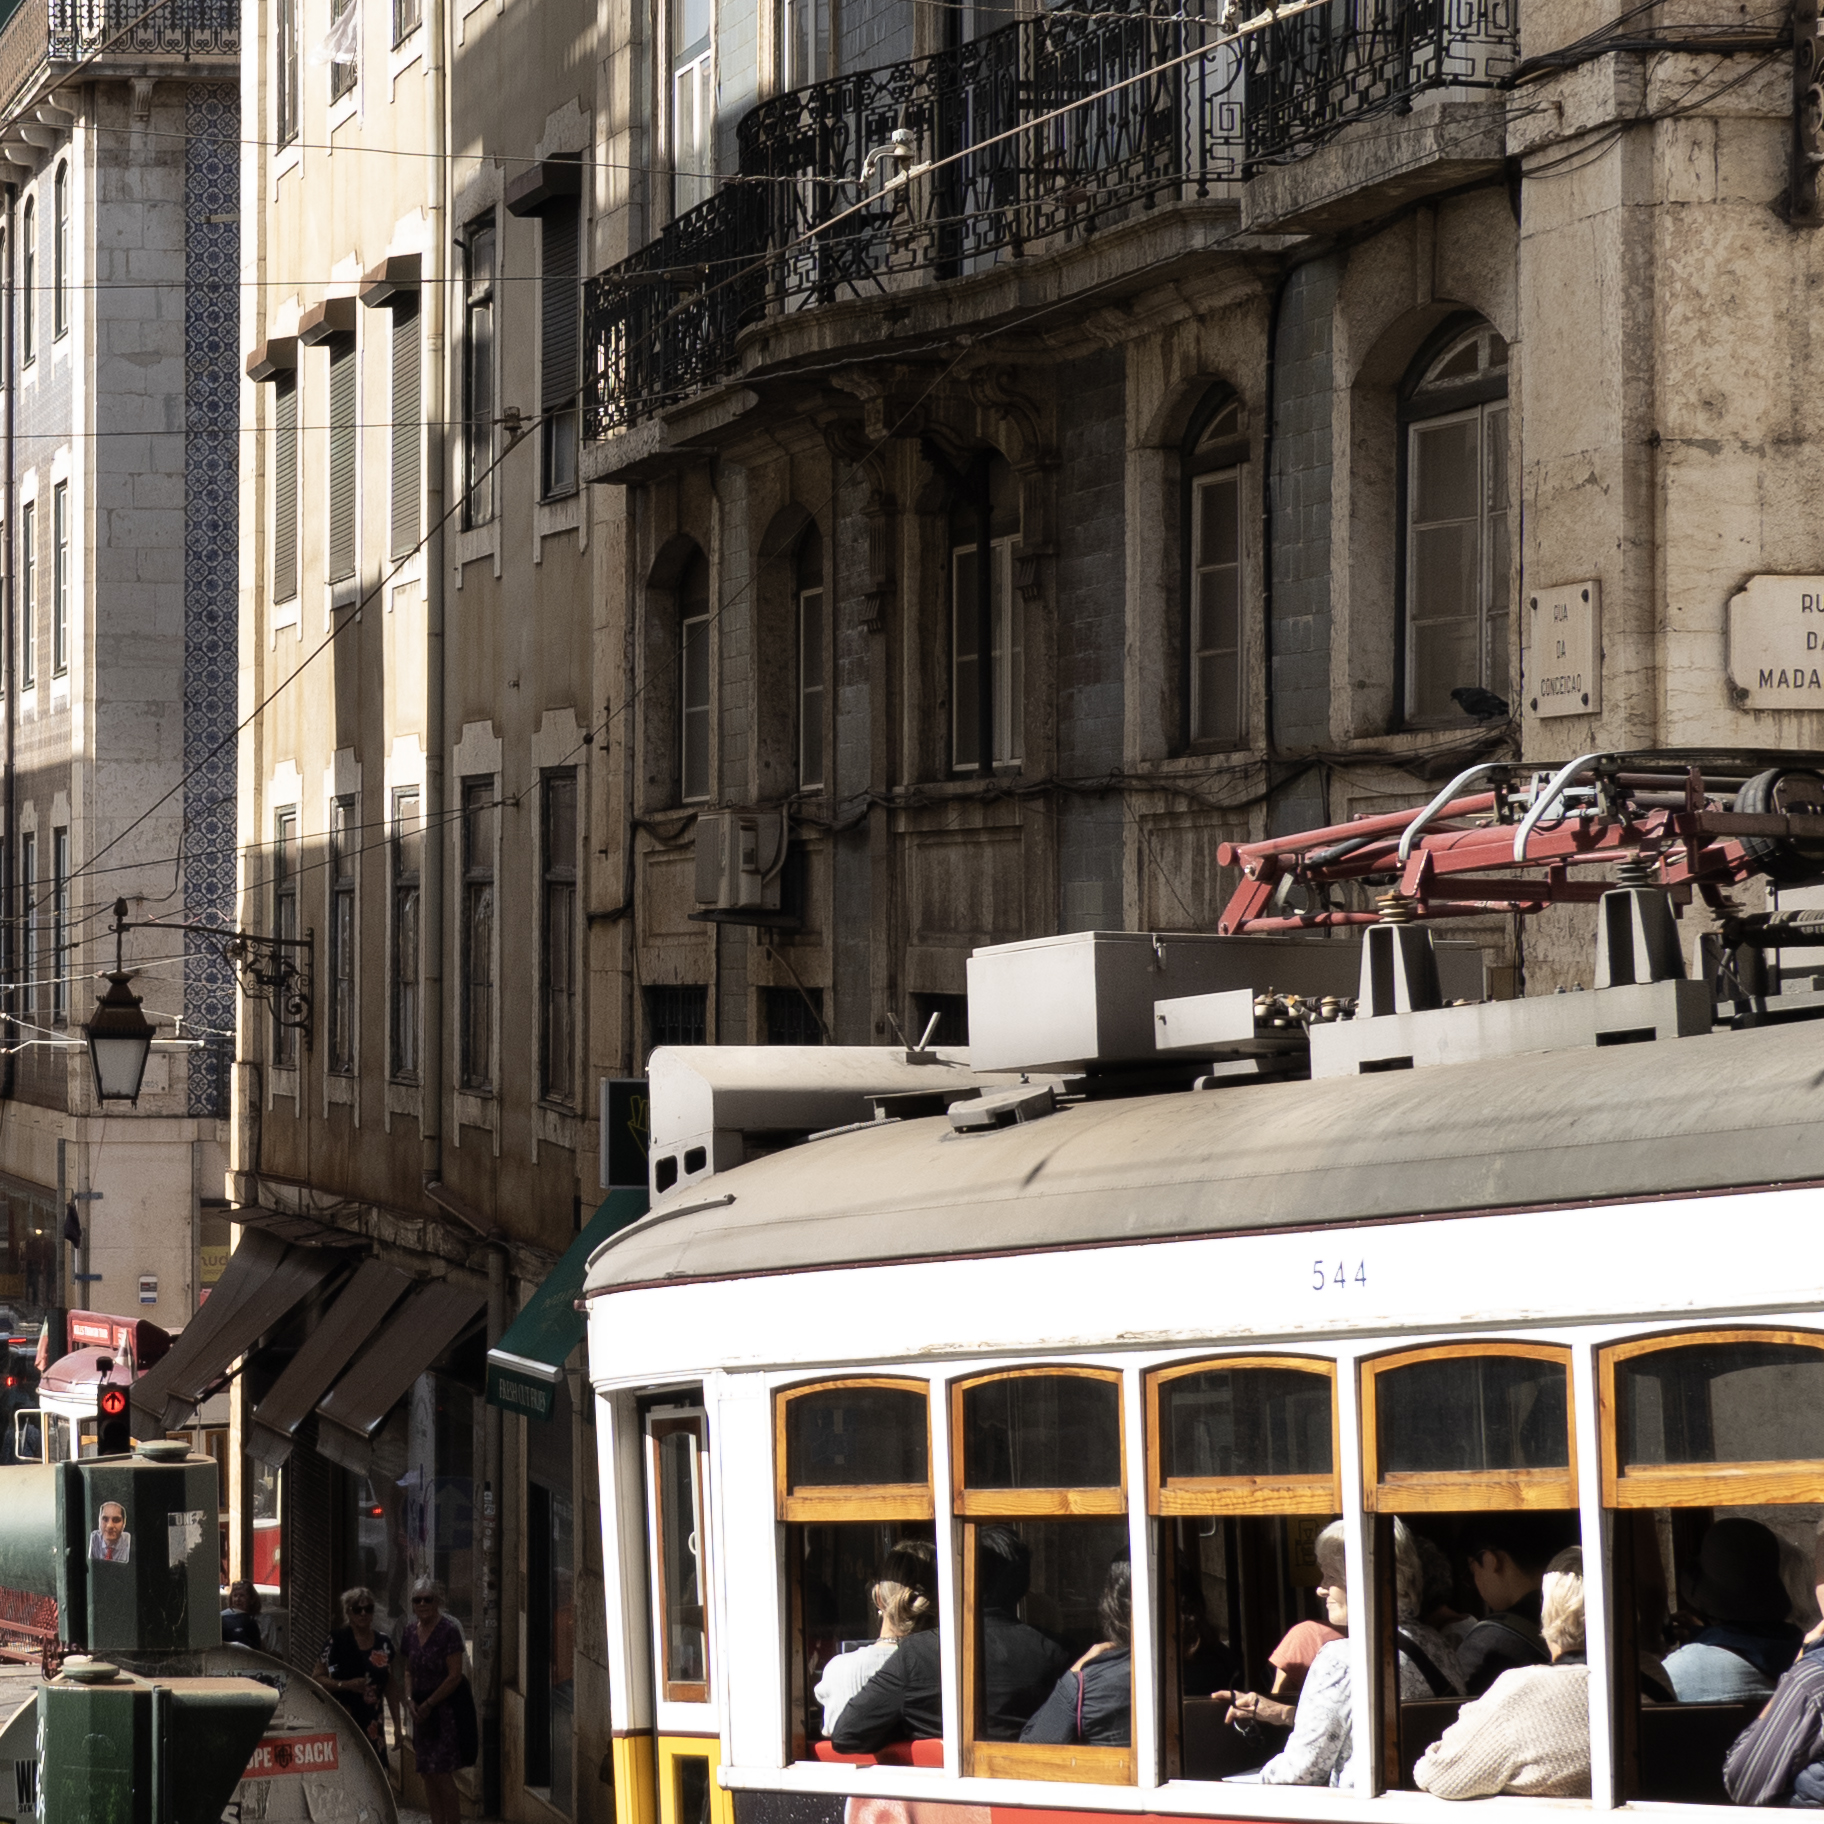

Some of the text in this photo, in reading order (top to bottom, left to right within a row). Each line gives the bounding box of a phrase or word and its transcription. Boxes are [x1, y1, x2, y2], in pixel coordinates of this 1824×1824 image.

[1553, 602, 1568, 623] RUA
[1801, 593, 1824, 613] RU
[1556, 639, 1566, 659] DA
[1806, 631, 1824, 650] D
[1758, 668, 1822, 689] MADA
[1312, 1258, 1367, 1291] 544
[294, 1740, 335, 1765] SACK
